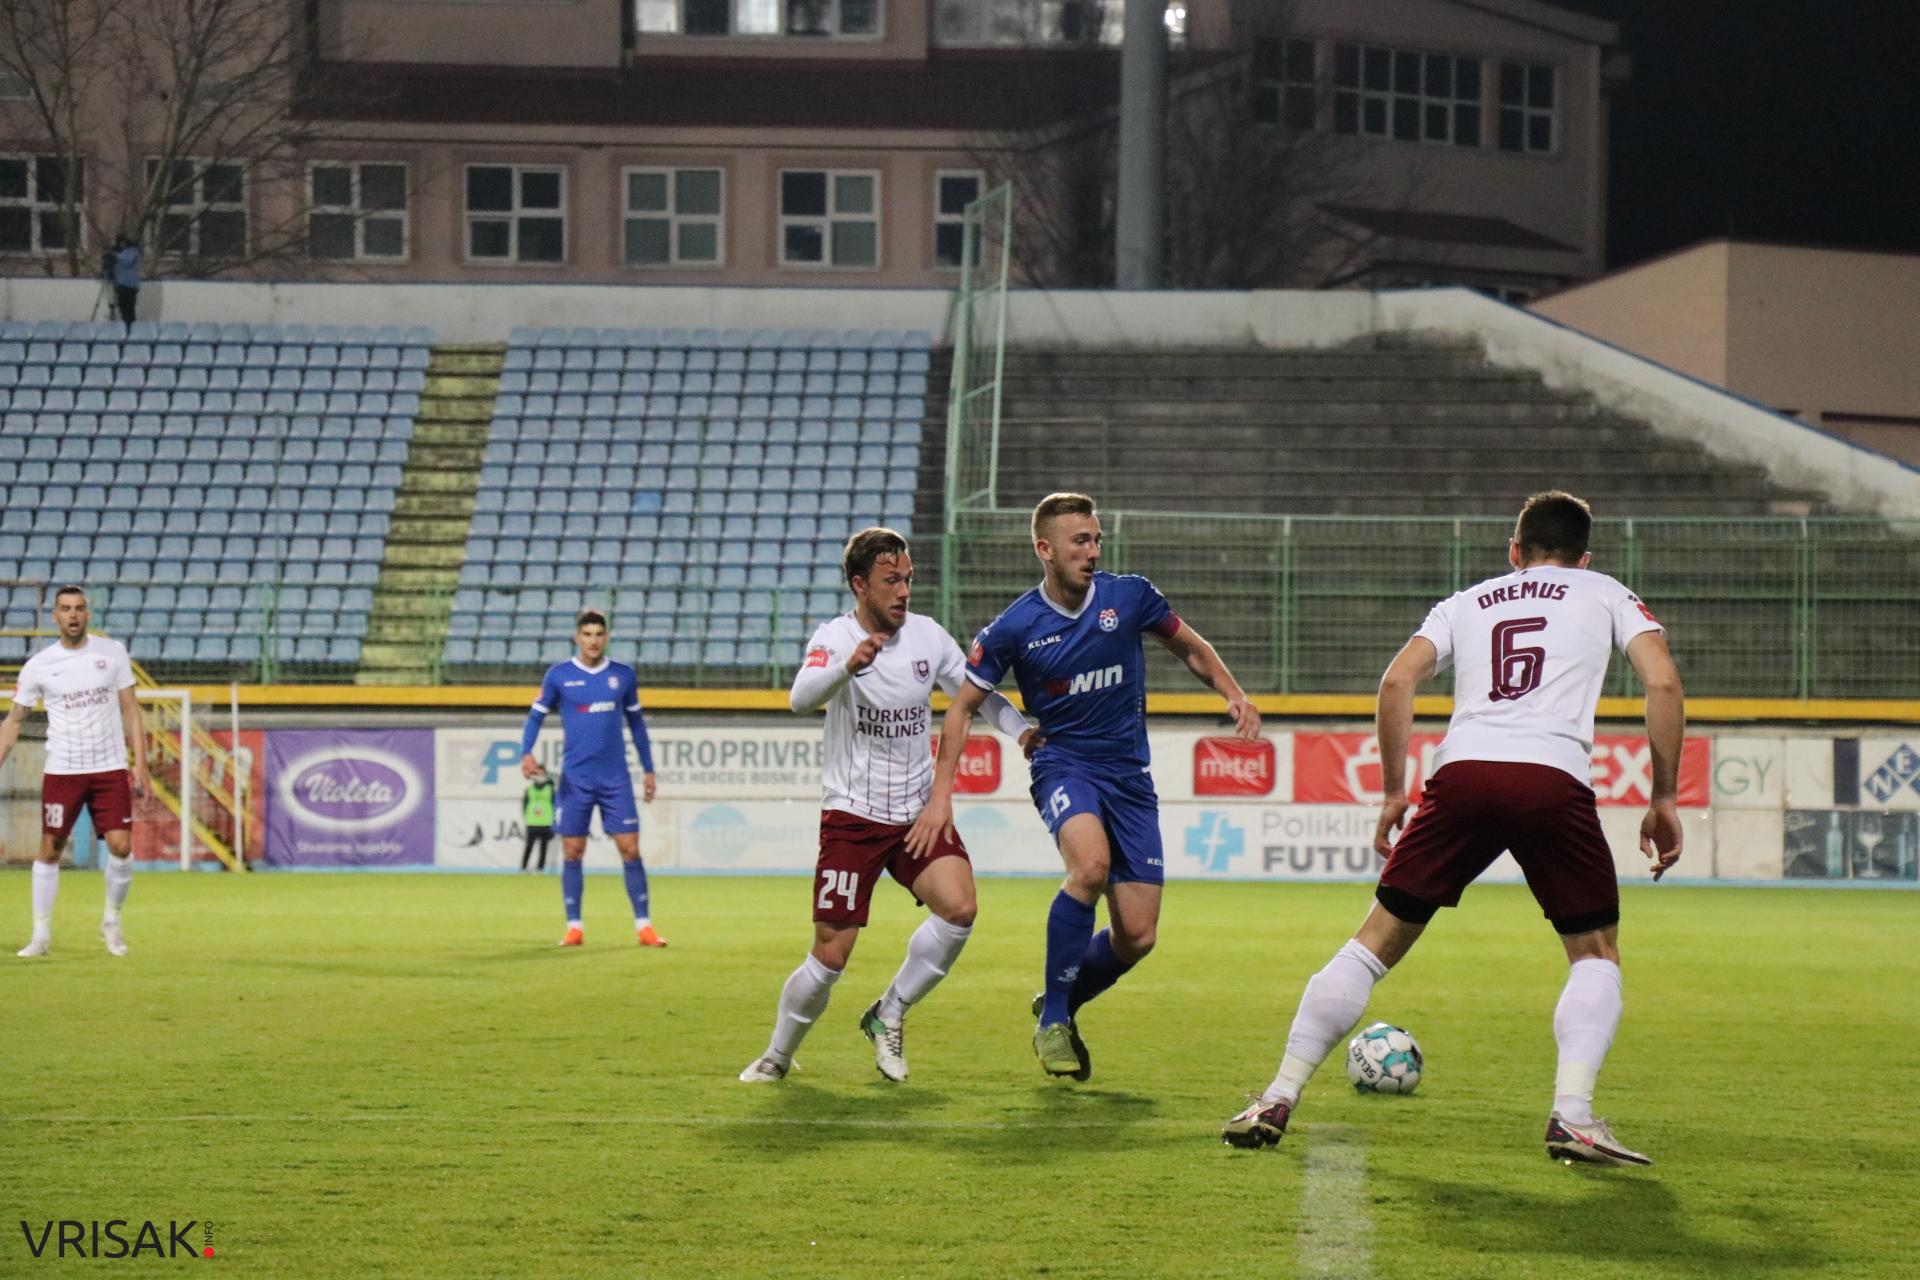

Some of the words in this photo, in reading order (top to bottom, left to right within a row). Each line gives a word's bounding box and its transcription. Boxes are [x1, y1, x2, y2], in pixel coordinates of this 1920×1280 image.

[1027, 634, 1062, 650] KELME
[1488, 616, 1549, 702] 6
[856, 703, 926, 723] TURKISH
[855, 719, 926, 738] AIRLINES
[305, 772, 394, 804] Violeta
[1261, 811, 1378, 838] Poliklin
[817, 869, 859, 911] 24
[1351, 1043, 1377, 1079] SELECT
